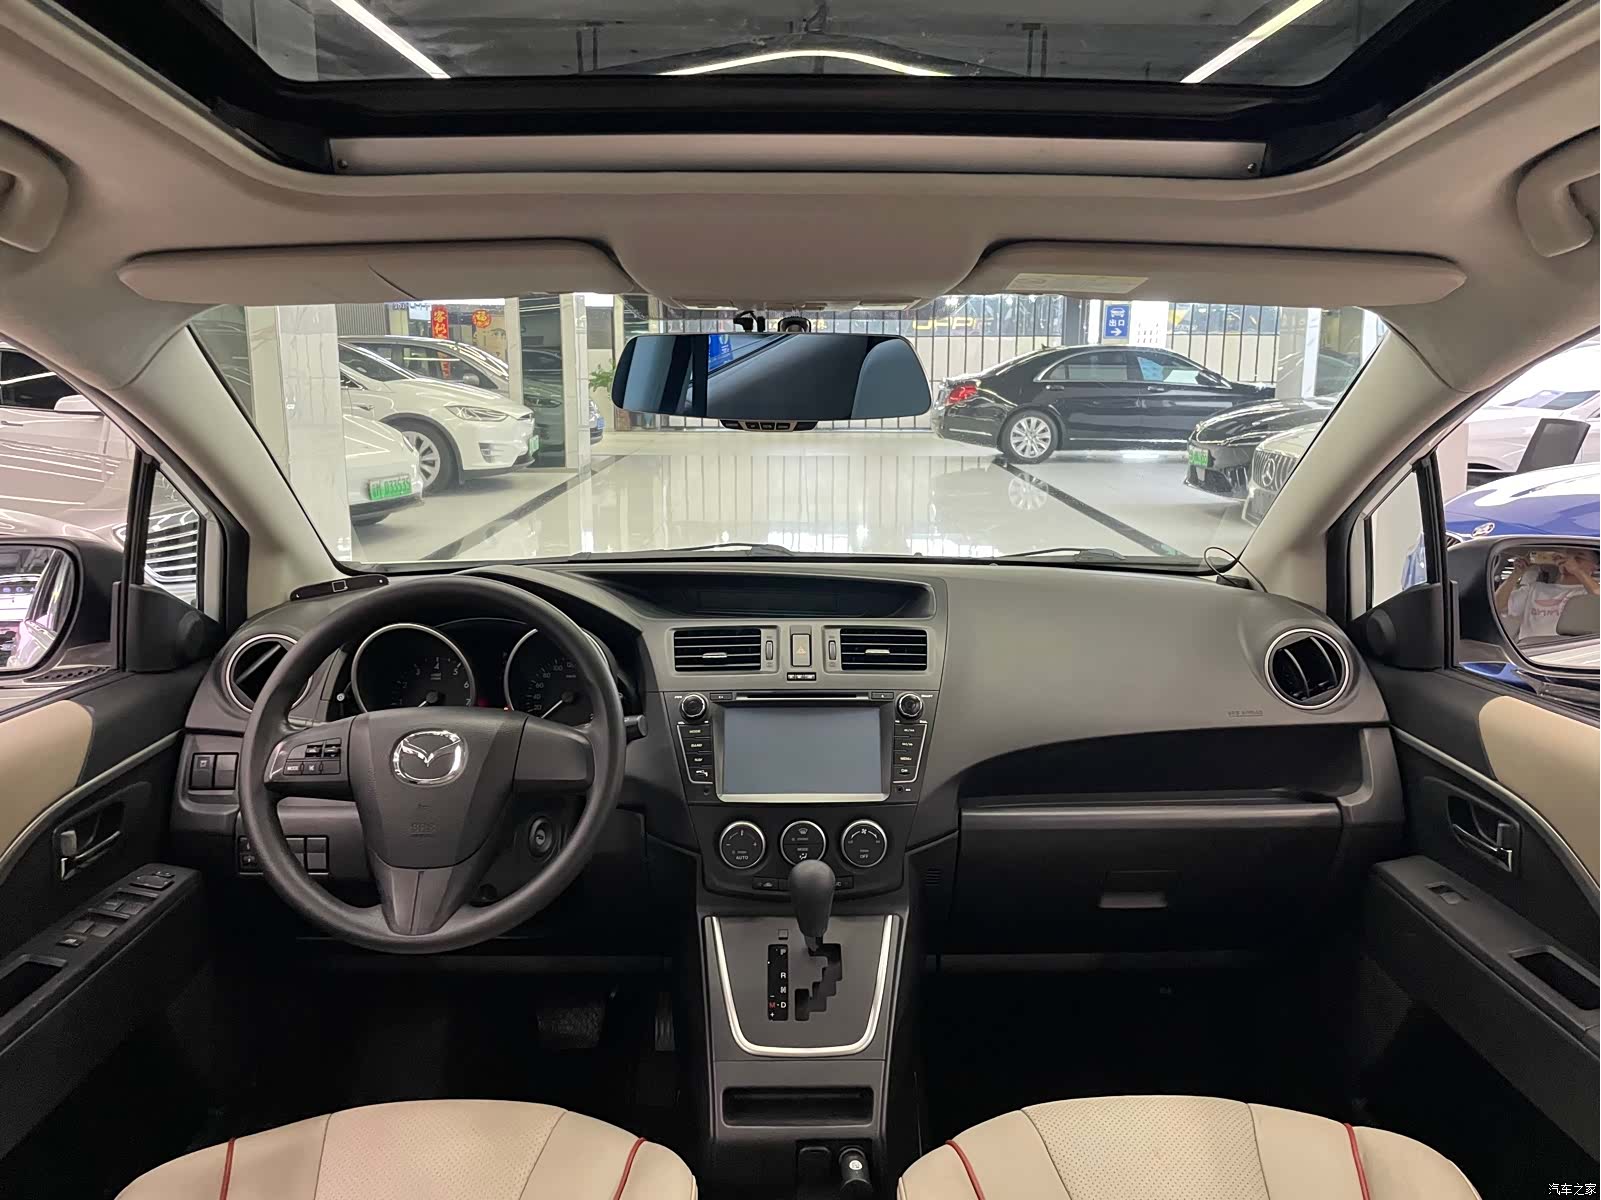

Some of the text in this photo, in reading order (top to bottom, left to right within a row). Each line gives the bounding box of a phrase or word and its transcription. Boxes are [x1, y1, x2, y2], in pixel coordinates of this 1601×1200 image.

[1109, 319, 1125, 327] 出口
[434, 662, 440, 670] 4
[453, 668, 459, 676] 5
[769, 1001, 787, 1009] M D
